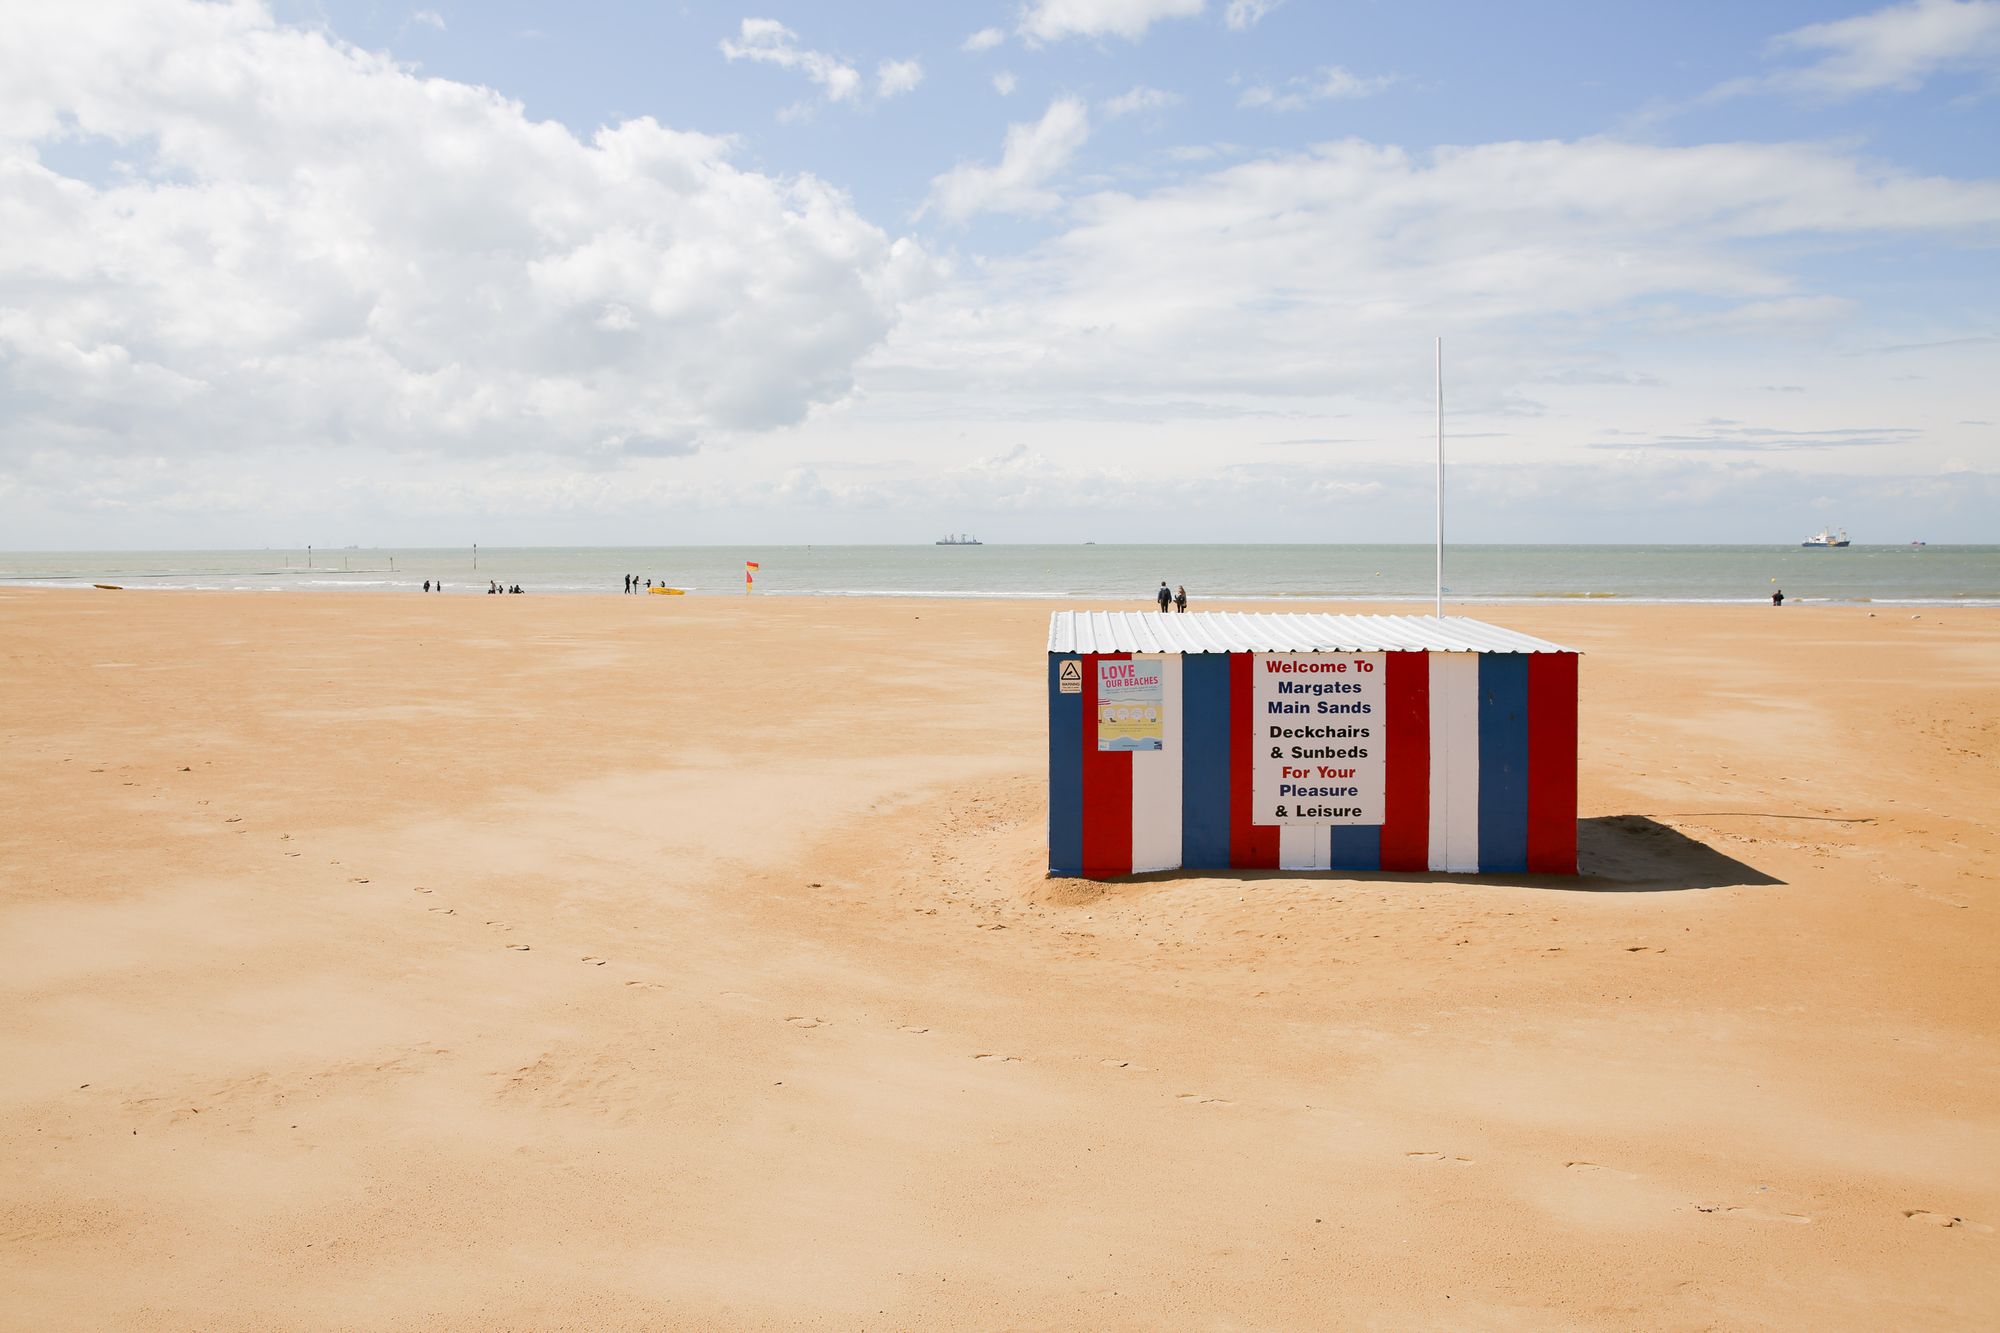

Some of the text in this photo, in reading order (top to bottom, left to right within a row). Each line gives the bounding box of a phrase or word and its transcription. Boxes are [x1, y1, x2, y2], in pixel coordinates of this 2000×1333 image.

[1101, 664, 1136, 680] LOVE
[1266, 660, 1374, 673] Welcome To
[1106, 676, 1159, 688] OUR BEACHES
[1278, 681, 1362, 696] Margates
[1268, 701, 1371, 714] Main Sands
[1270, 725, 1370, 738] Deckchairs
[1270, 746, 1368, 759] & Sunbeds
[1282, 766, 1356, 778] For Your
[1280, 784, 1358, 796] Pleasure
[1275, 805, 1362, 817] & Leisure
